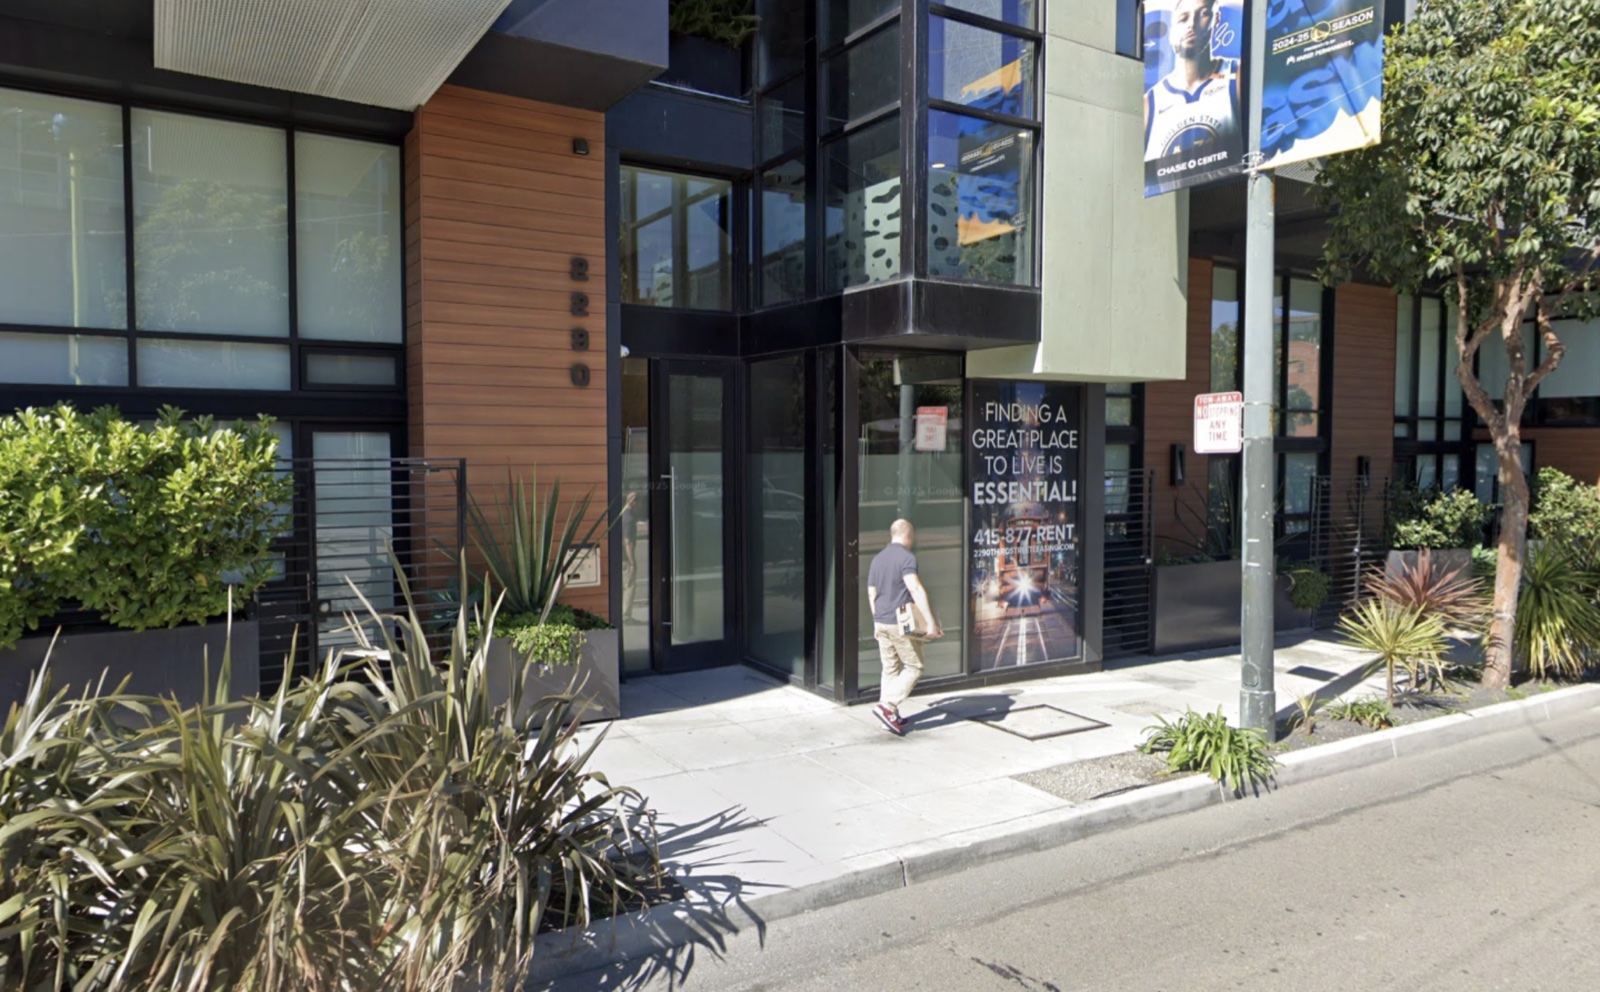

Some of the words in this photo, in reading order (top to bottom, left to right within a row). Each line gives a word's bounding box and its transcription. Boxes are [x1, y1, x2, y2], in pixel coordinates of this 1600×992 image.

[1331, 10, 1374, 31] SEASON
[1157, 162, 1188, 177] CHASE
[1197, 151, 1228, 167] CENTER
[985, 402, 1052, 423] FINDING
[1055, 404, 1067, 423] A
[1209, 420, 1227, 430] ANY
[972, 428, 1026, 449] GREAT
[1030, 429, 1078, 449] PLACE
[1208, 430, 1228, 442] TIME
[984, 455, 1008, 475] TO
[1012, 455, 1045, 474] LIVE
[1049, 455, 1063, 474] IS
[973, 480, 1077, 505] ESSENTIAL!
[973, 523, 1075, 546] 415-877-RENT
